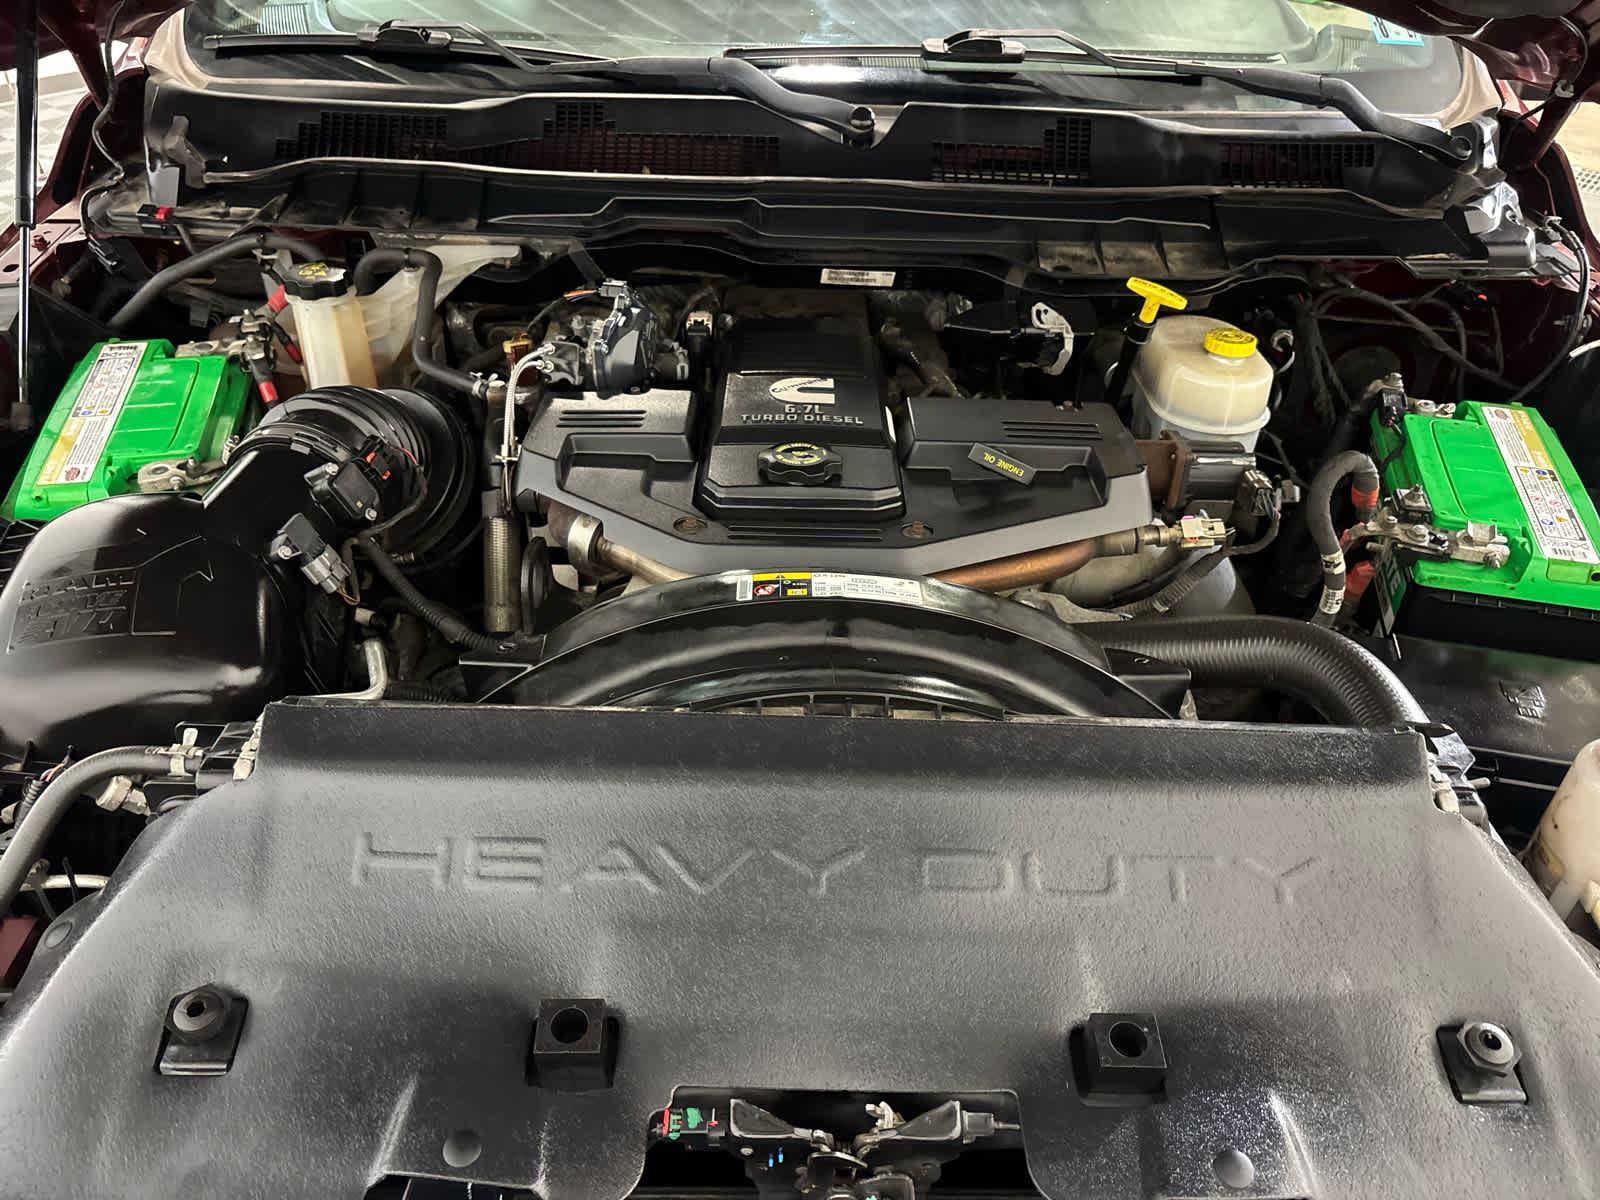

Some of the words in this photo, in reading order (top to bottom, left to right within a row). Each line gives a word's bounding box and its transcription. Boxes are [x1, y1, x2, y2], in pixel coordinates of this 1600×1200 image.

[784, 403, 824, 414] 6.7L
[741, 413, 798, 422] TURBO
[803, 414, 864, 425] DIESEL
[983, 451, 997, 464] OIL
[995, 459, 1025, 477] ENGINE
[350, 831, 868, 898] HEAVY
[918, 847, 1318, 904] DUTY
